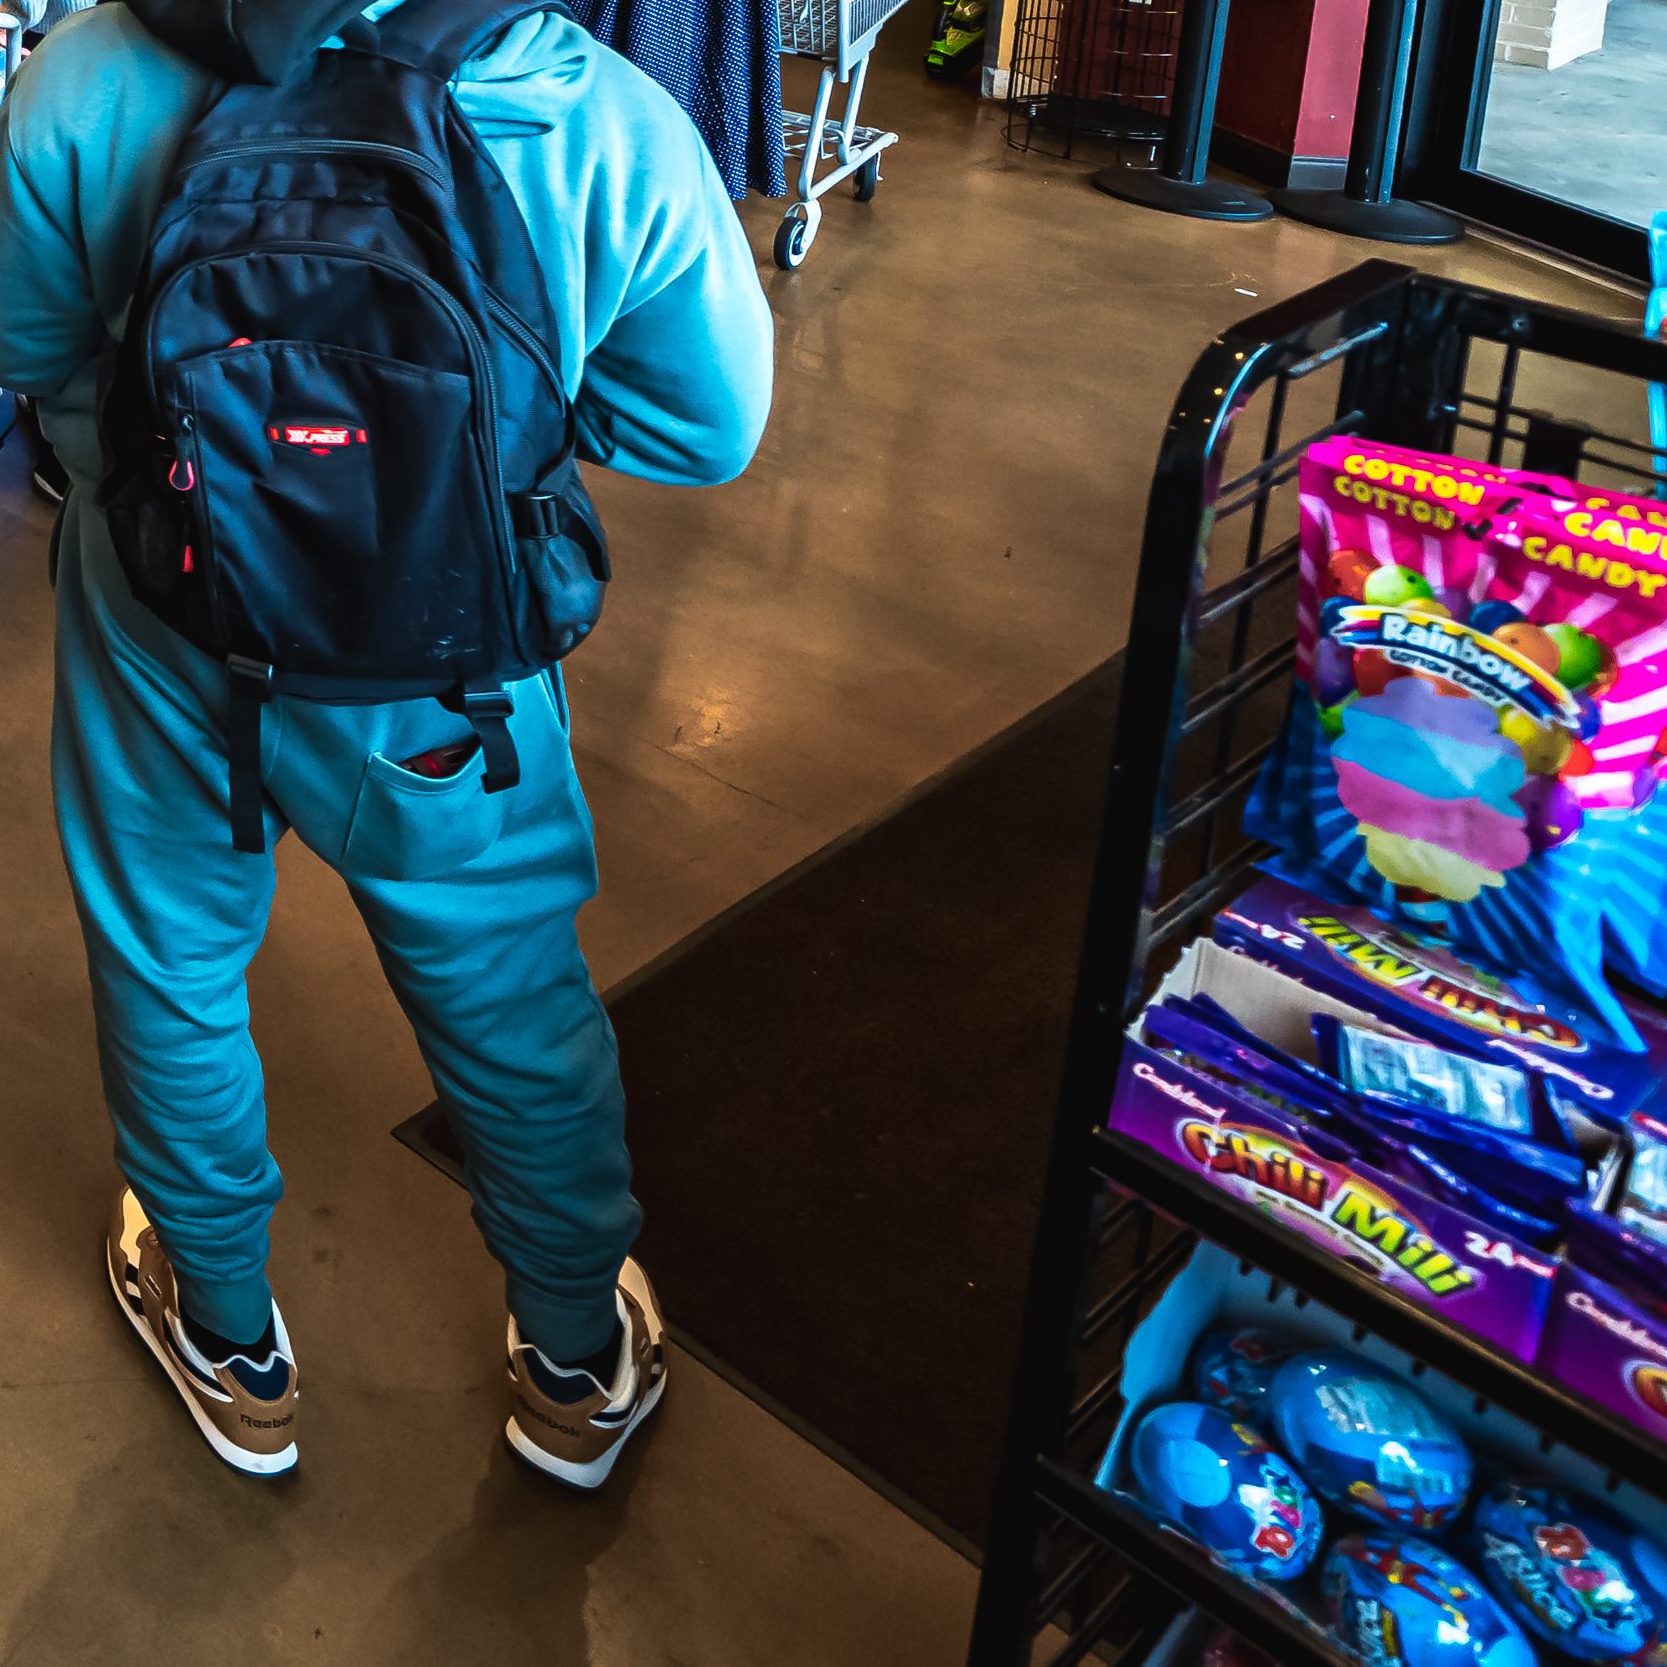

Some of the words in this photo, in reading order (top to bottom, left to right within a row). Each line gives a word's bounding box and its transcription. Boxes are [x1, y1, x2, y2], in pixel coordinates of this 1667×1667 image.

[1332, 474, 1456, 531] COTTON
[1344, 453, 1485, 506] COTTON
[1522, 535, 1667, 598] CANDY
[1382, 614, 1532, 691] Rainbow
[1181, 1123, 1328, 1212] Chili
[1333, 1188, 1475, 1298] Mili
